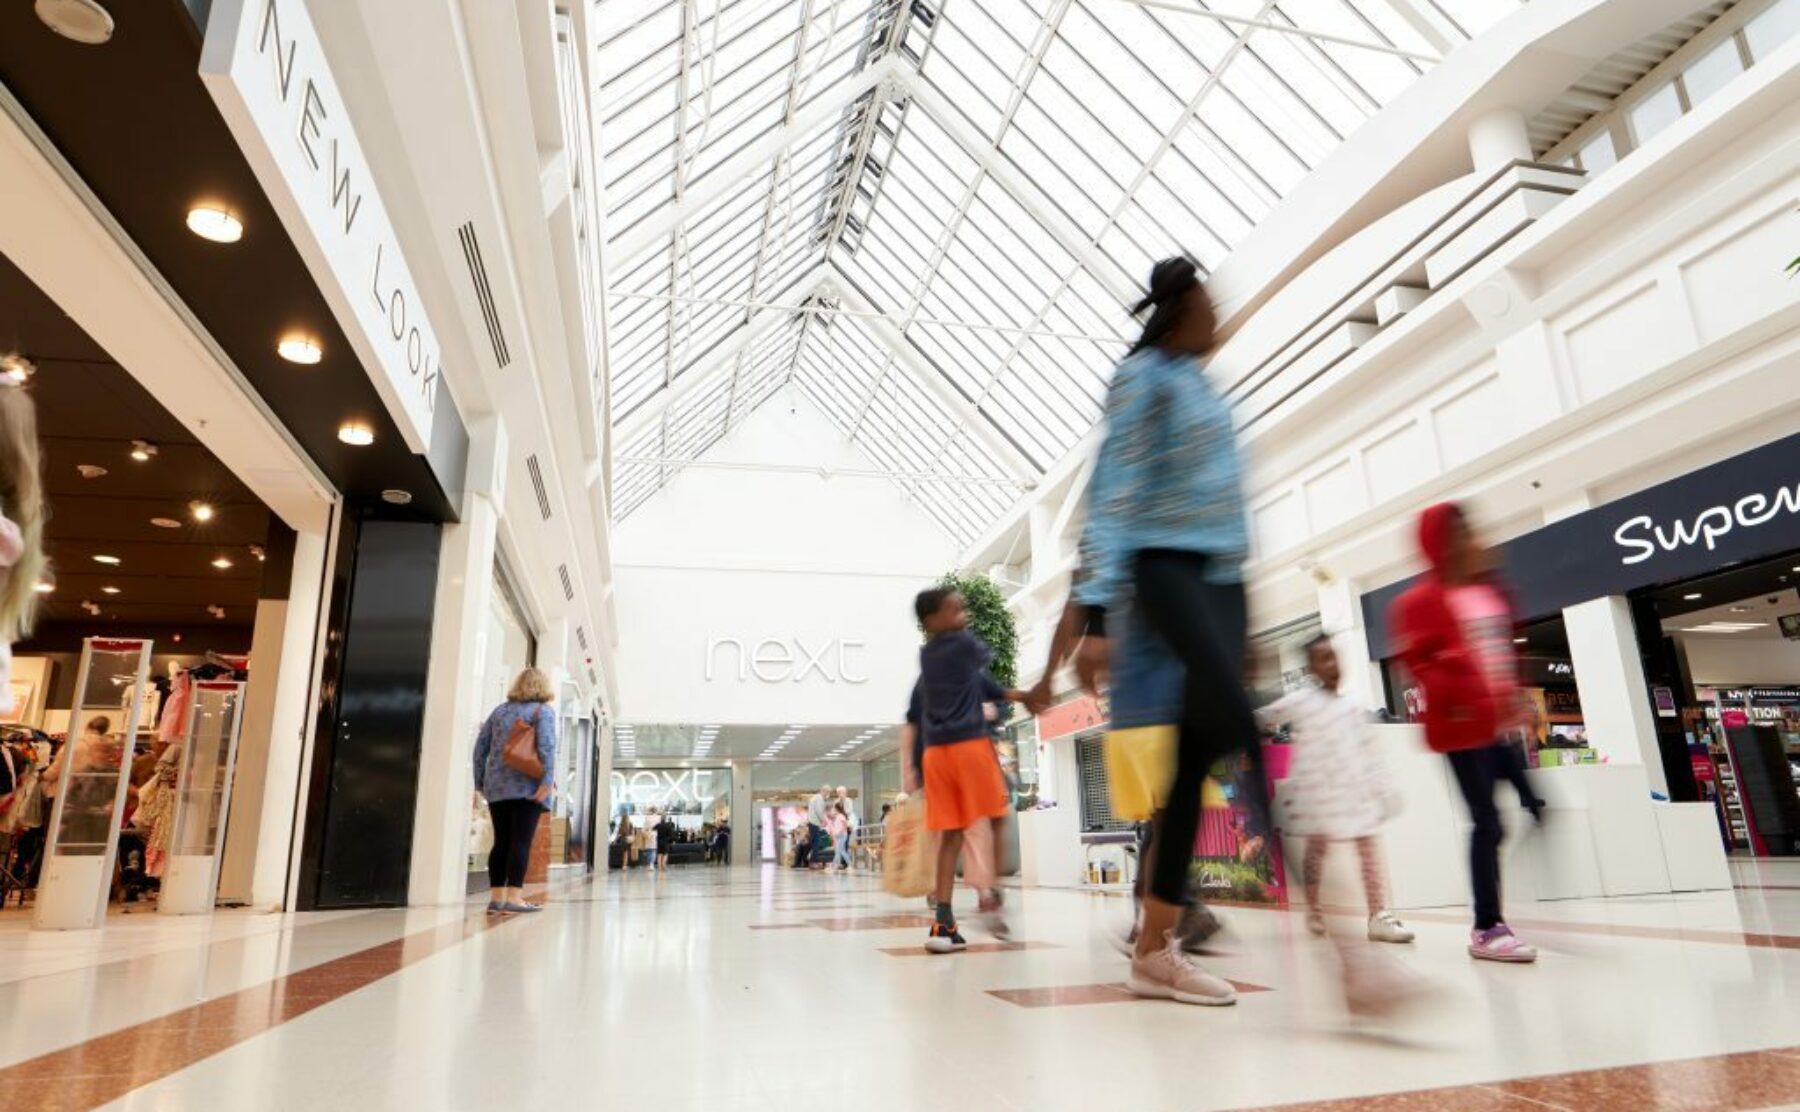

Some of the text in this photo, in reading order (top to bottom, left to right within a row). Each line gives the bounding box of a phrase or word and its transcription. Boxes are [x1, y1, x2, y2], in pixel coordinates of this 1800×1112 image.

[260, 0, 437, 413] NEW LOOK
[705, 635, 871, 684] next
[610, 768, 715, 802] next
